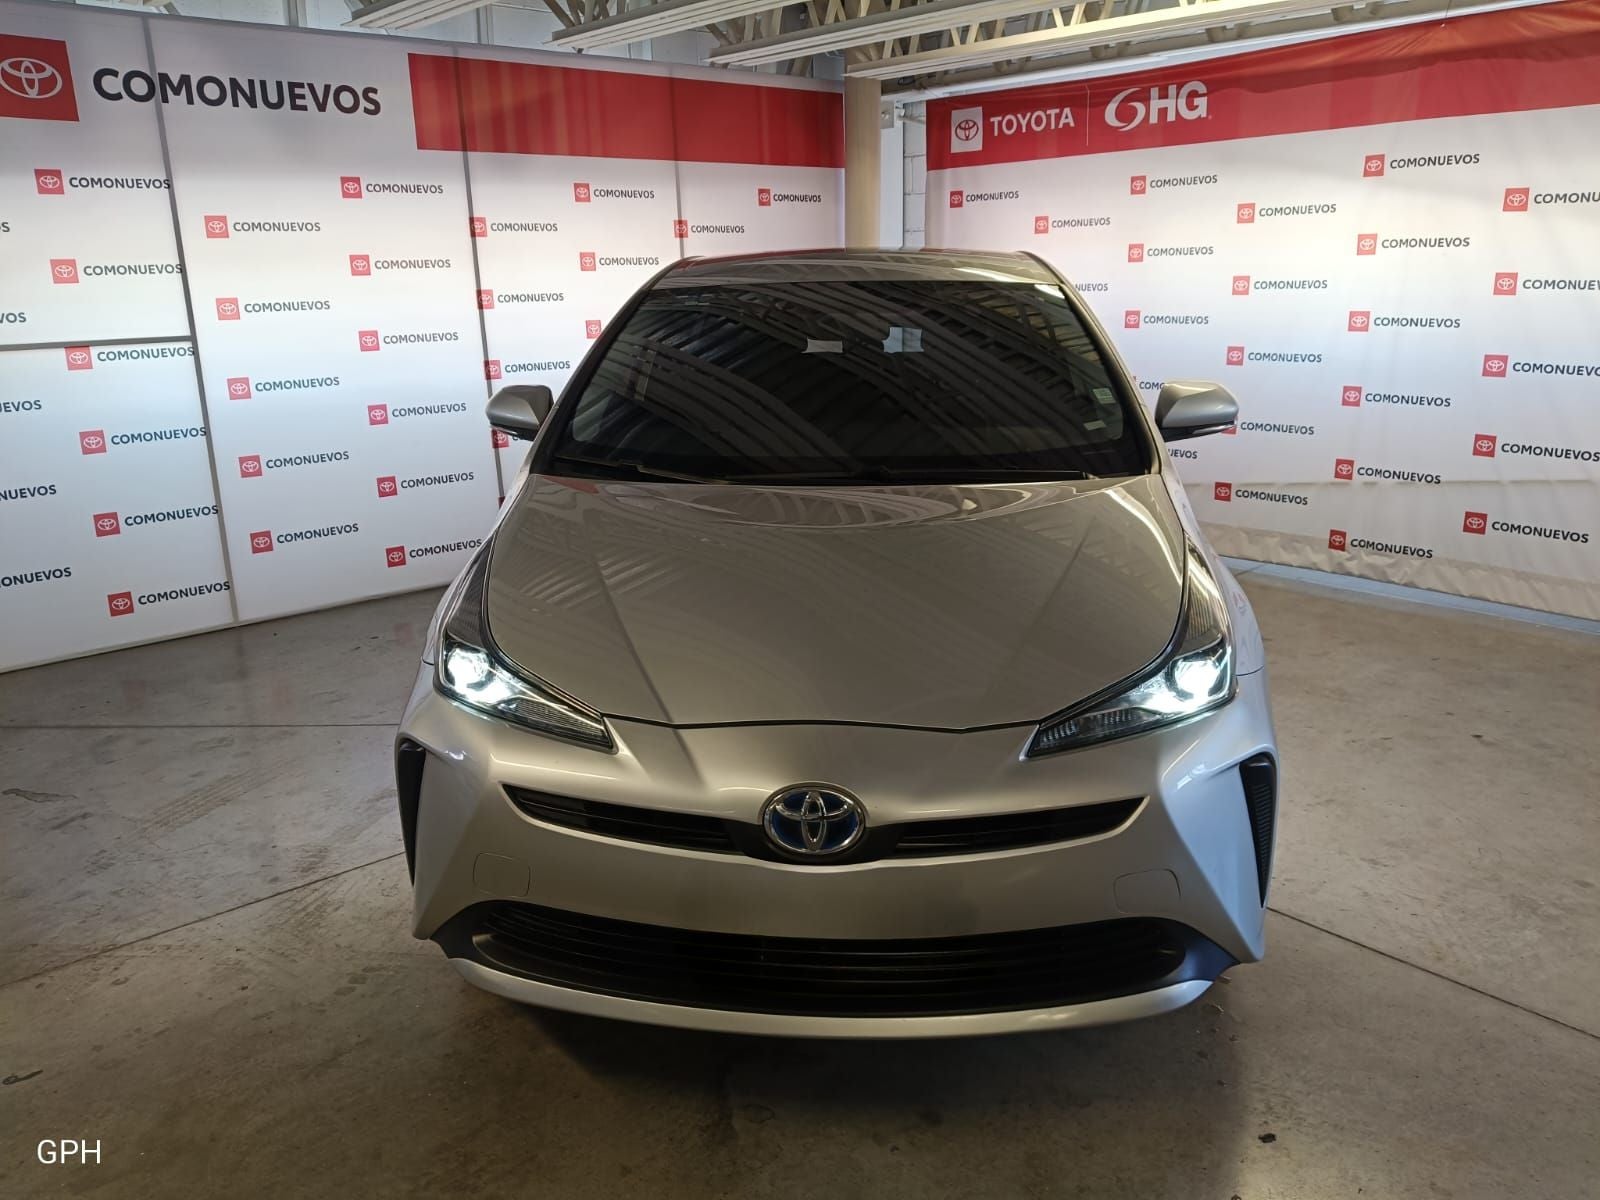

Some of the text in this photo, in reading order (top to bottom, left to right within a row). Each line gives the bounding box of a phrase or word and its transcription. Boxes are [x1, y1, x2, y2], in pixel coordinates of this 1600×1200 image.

[92, 66, 382, 116] COMONUEVOS
[990, 106, 1076, 137] TOYOTA
[1389, 153, 1480, 170] COMONUEVOS
[68, 176, 170, 190] COMONUEVOS
[1149, 174, 1218, 189] COMONUEVOS
[365, 183, 444, 195] COMONUEVOS
[593, 188, 655, 199] COMONUEVOS
[773, 193, 822, 203] COMONUEVOS
[965, 190, 1019, 203] COMONUEVOS
[1534, 191, 1600, 204] COMONU
[1258, 204, 1337, 217] COMONUEVOS
[233, 221, 321, 233] COMONUEVOS
[490, 222, 558, 232] COMONUEVOS
[690, 224, 745, 234] COMONUEVOS
[1051, 217, 1111, 229] COMONUEVOS
[1381, 237, 1471, 249] COMONUEVOS
[1146, 246, 1214, 257] COMONUEVOS
[374, 259, 451, 270] COMONUEVOS
[599, 257, 659, 266] COMONUEVOS
[84, 263, 183, 276] COMONUEVOS
[1075, 282, 1109, 292] NUEVOS
[1253, 280, 1328, 290] COMONUEVOS
[1522, 279, 1600, 290] COMONUE
[497, 293, 564, 303] COMONUEVOS
[244, 300, 331, 313] COMONUEVOS
[1143, 315, 1209, 325] COMONUEVOS
[1373, 317, 1461, 329] COMONUEVOS
[383, 332, 459, 345] COMONUEVOS
[97, 346, 195, 362] COMONUEVOS
[1247, 352, 1322, 363] COMONUEVOS
[504, 361, 571, 374] COMONUEVOS
[1512, 362, 1600, 377] COMONUEVO
[255, 376, 340, 392] COMONUEVOS
[1364, 393, 1451, 408] COMONUEVOS
[392, 402, 467, 418] COMONUEVOS
[1240, 421, 1315, 436] COMONUEVOS
[111, 426, 207, 445] COMONUEVOS
[1501, 443, 1600, 462] COMONUEVOS
[266, 451, 350, 469] COMONUEVOS
[400, 471, 475, 489] COMONUEVOS
[1357, 466, 1441, 485] COMONUEVOS
[0, 484, 57, 501] NUEVOS
[1235, 488, 1308, 506] COMONUEVOS
[125, 505, 219, 526] COMONUEVOS
[277, 523, 359, 544] COMONUEVOS
[1491, 520, 1589, 544] COMONUEVOS
[409, 538, 482, 558] COMONUEVOS
[1350, 538, 1433, 559] COMONUEVOS
[0, 567, 72, 588] ONUEVOS
[138, 581, 231, 605] COMONUEVOS
